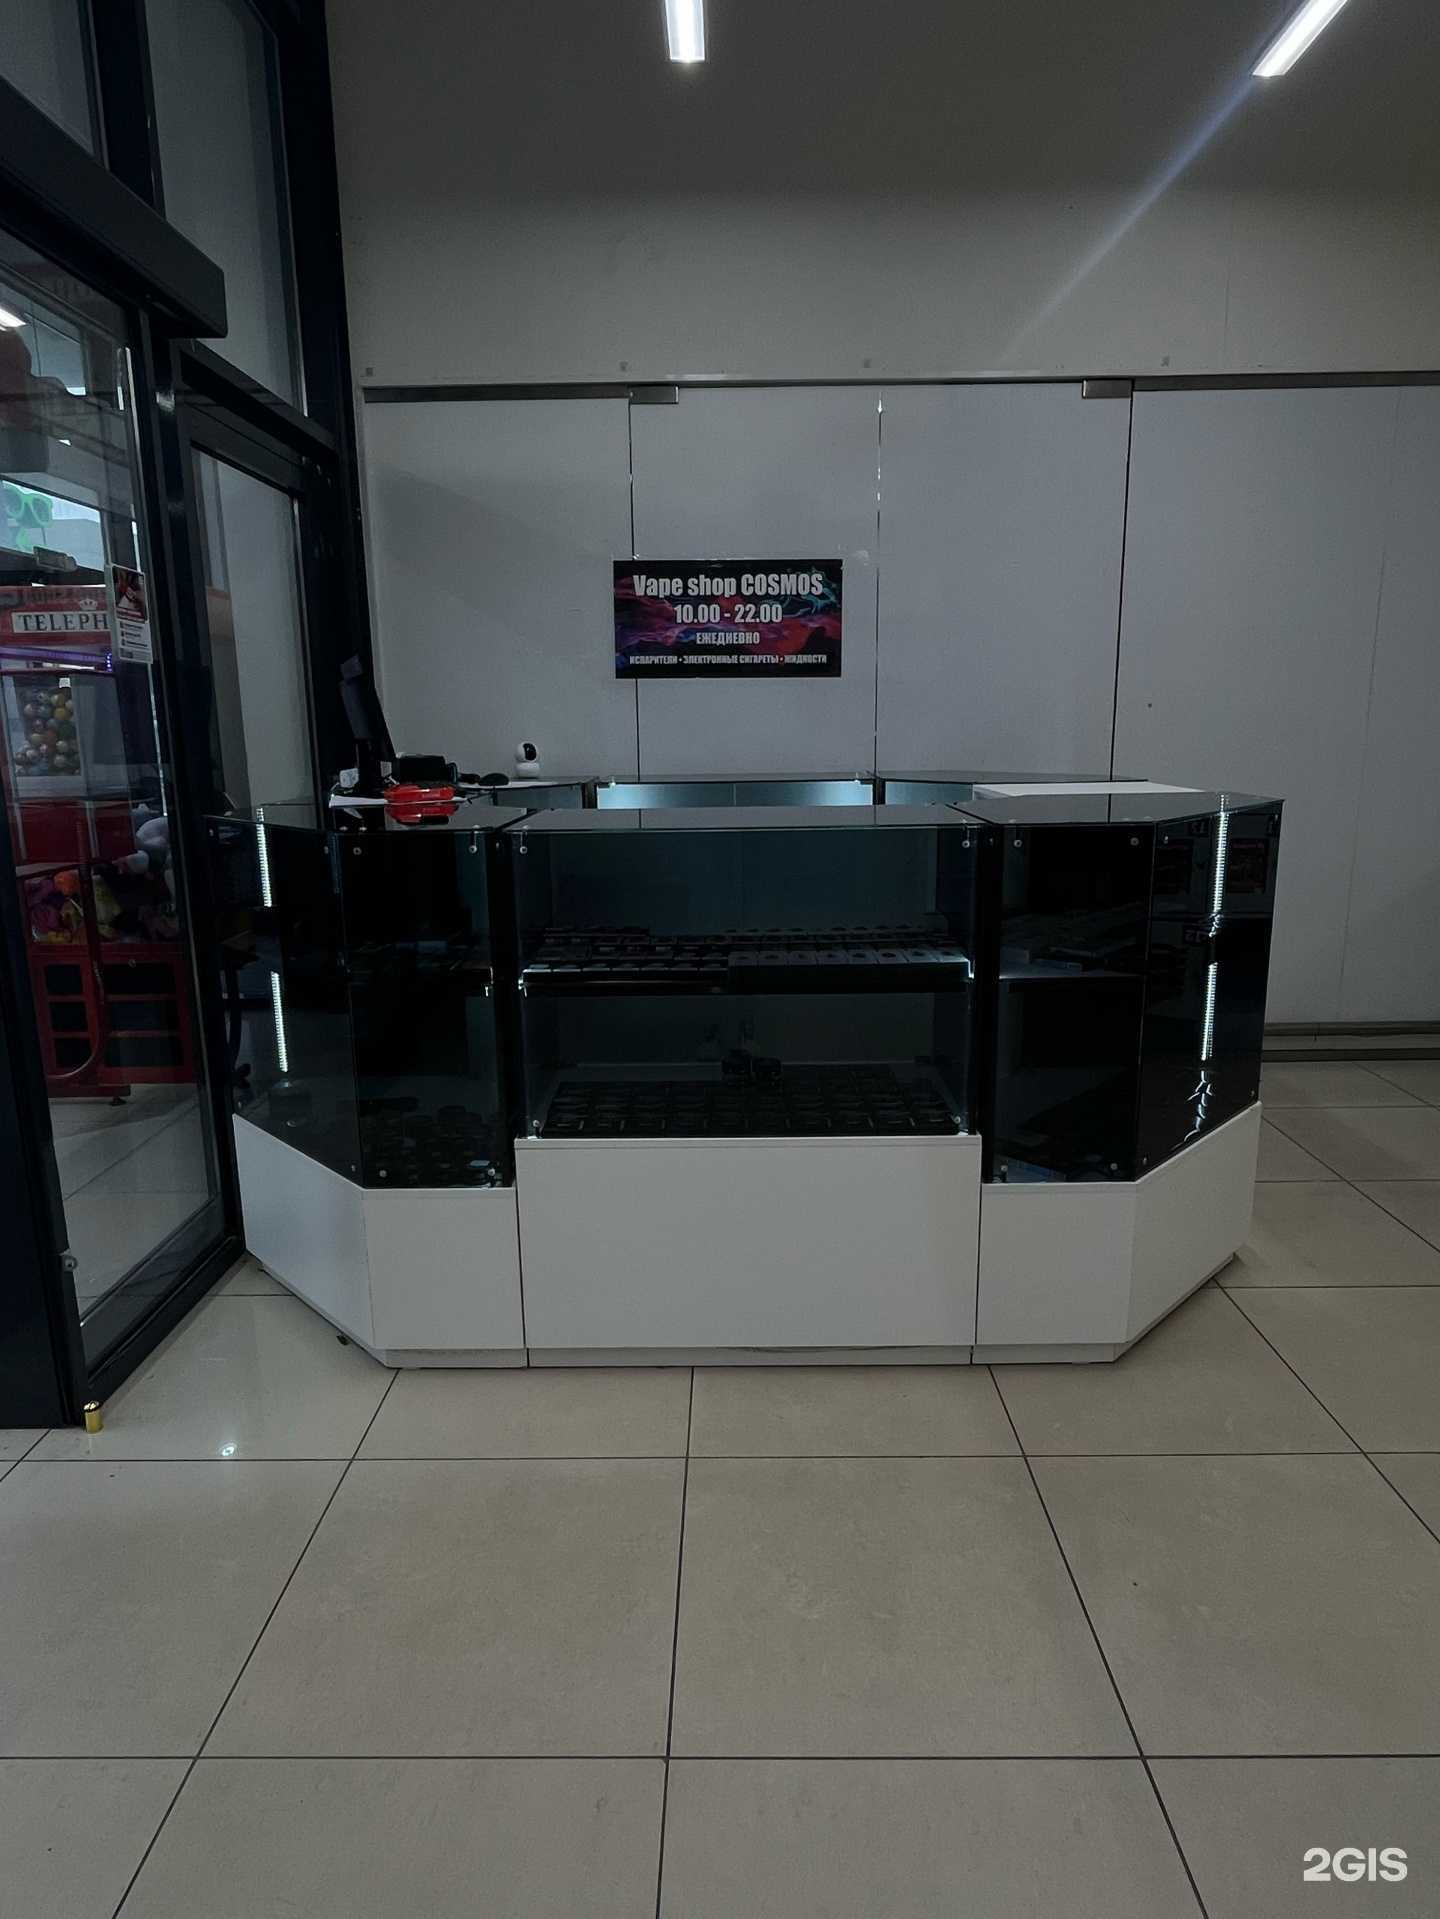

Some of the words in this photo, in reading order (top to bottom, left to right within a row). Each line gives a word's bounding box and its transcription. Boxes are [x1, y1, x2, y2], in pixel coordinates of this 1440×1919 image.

[633, 574, 684, 598] Vape
[687, 574, 737, 598] shop
[740, 573, 824, 596] COSMOS
[18, 613, 109, 632] TELEPH
[675, 604, 720, 624] 10.00
[734, 604, 783, 624] 22.00
[695, 631, 761, 646] ЕЖЕДНЕВНО
[629, 655, 678, 665] ИСПАРИТЕЛИ
[683, 654, 738, 664] ЭЛЕКТРОННЫЕ
[739, 654, 779, 664] СИГАРЕТЫ
[783, 654, 828, 664] ЖИДКОСТИ
